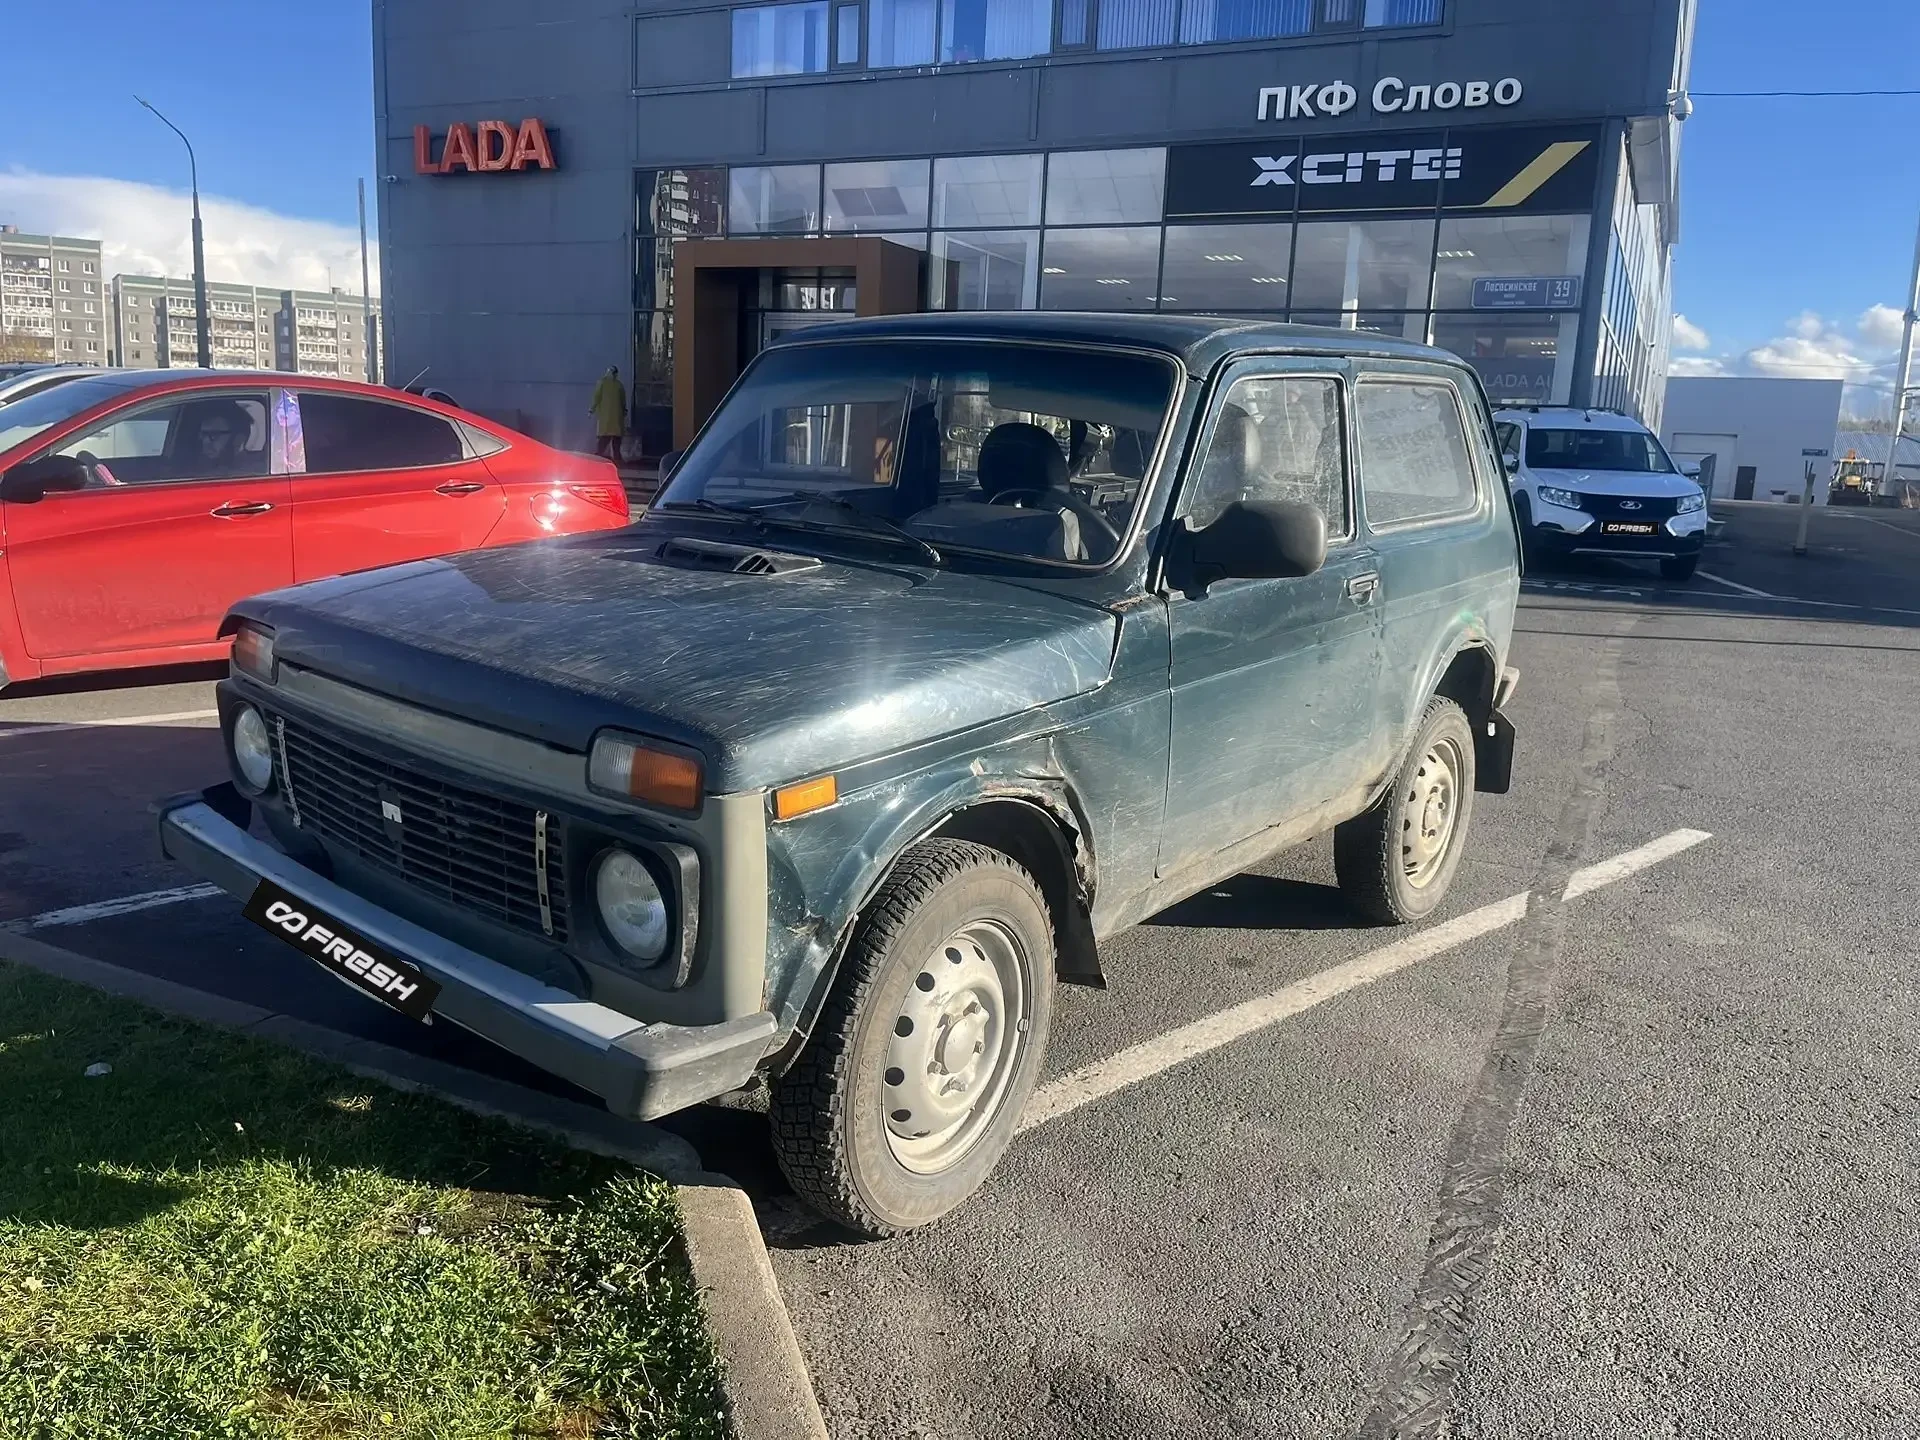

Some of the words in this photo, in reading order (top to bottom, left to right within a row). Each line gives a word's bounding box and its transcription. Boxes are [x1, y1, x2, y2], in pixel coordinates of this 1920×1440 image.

[1257, 80, 1358, 121] ПКФ
[1372, 76, 1523, 113] Слово
[414, 117, 557, 175] LADA
[1250, 147, 1463, 186] XCITE
[1553, 280, 1571, 298] 39
[1483, 373, 1529, 388] LADA
